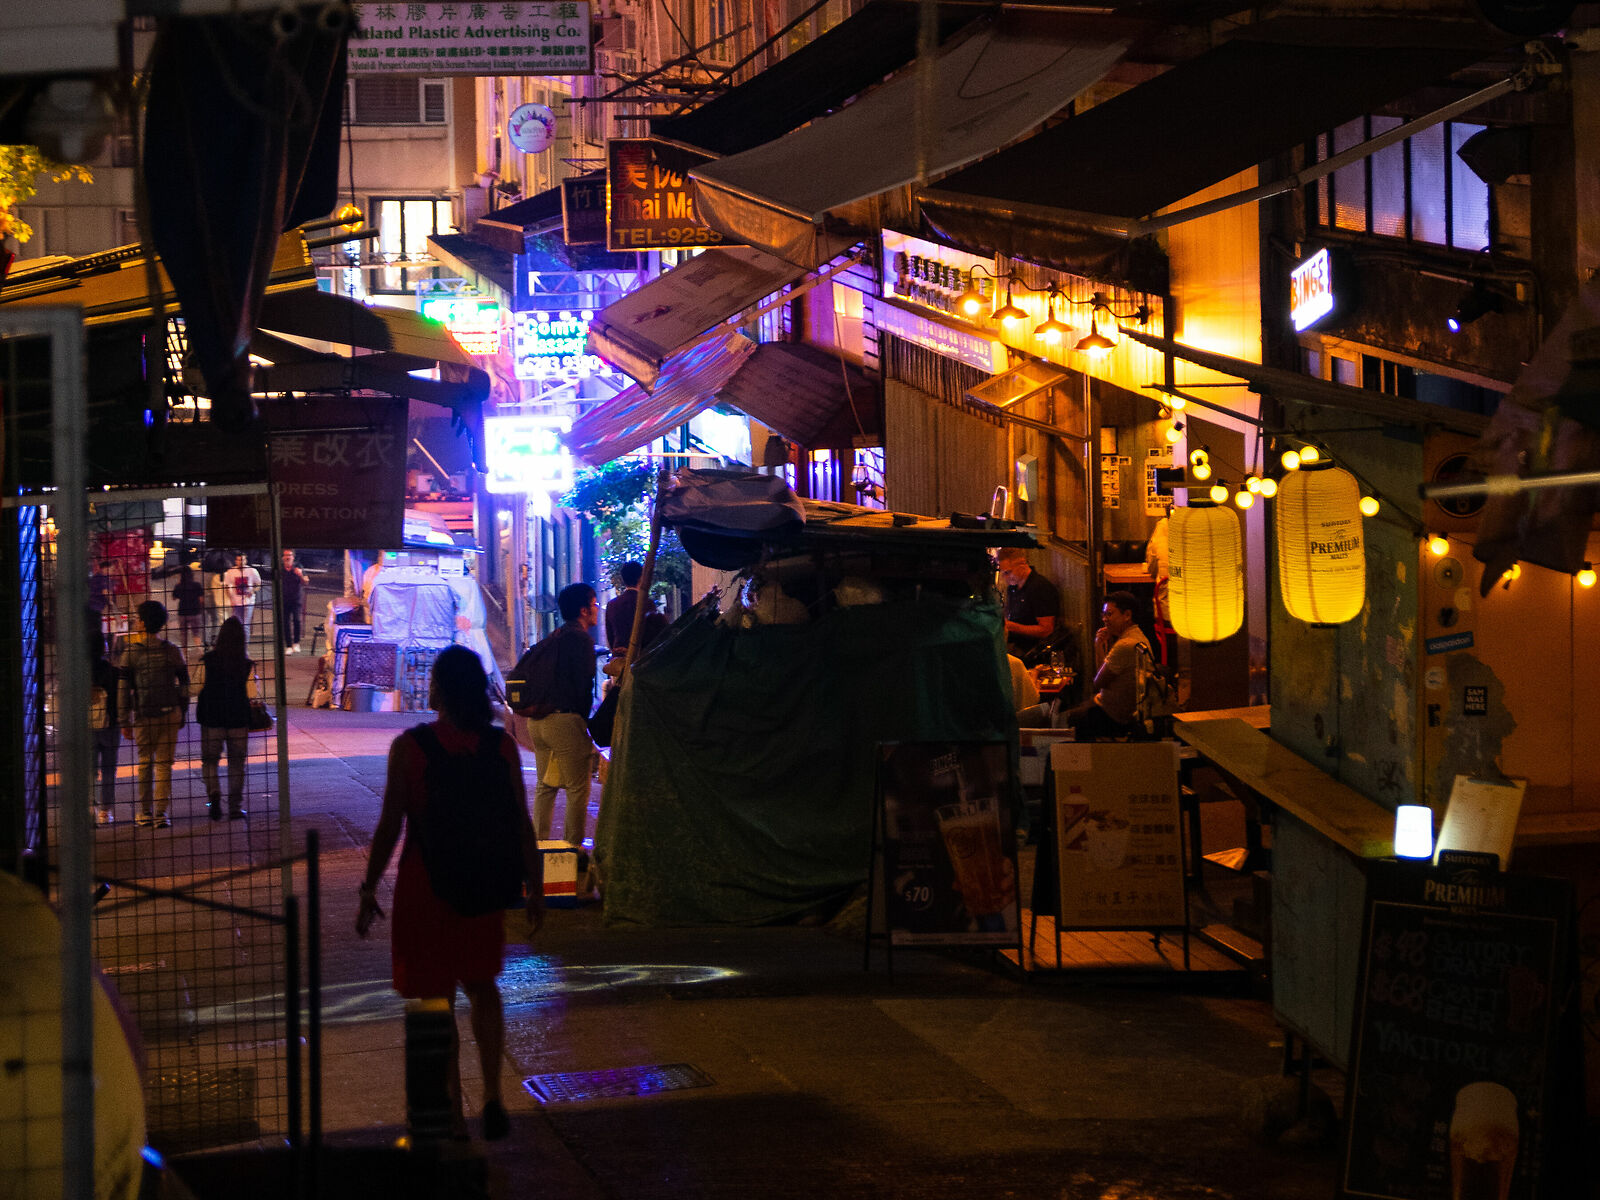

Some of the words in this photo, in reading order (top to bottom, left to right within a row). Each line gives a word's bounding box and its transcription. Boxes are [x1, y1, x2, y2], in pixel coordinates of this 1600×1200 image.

[409, 25, 459, 39] Plastic
[464, 24, 550, 42] Advertising
[556, 24, 581, 38] Co.
[617, 193, 661, 221] Thai
[1290, 256, 1324, 312] BINGE
[525, 317, 588, 337] Comfy
[272, 483, 338, 496] DRESS
[1310, 536, 1360, 554] PREMIUM
[1444, 853, 1492, 865] SUNTORY
[904, 886, 930, 903] $70
[1425, 878, 1505, 906] PREMIUM
[1425, 998, 1495, 1036] BEER
[1372, 1020, 1490, 1073] YAKITORI
